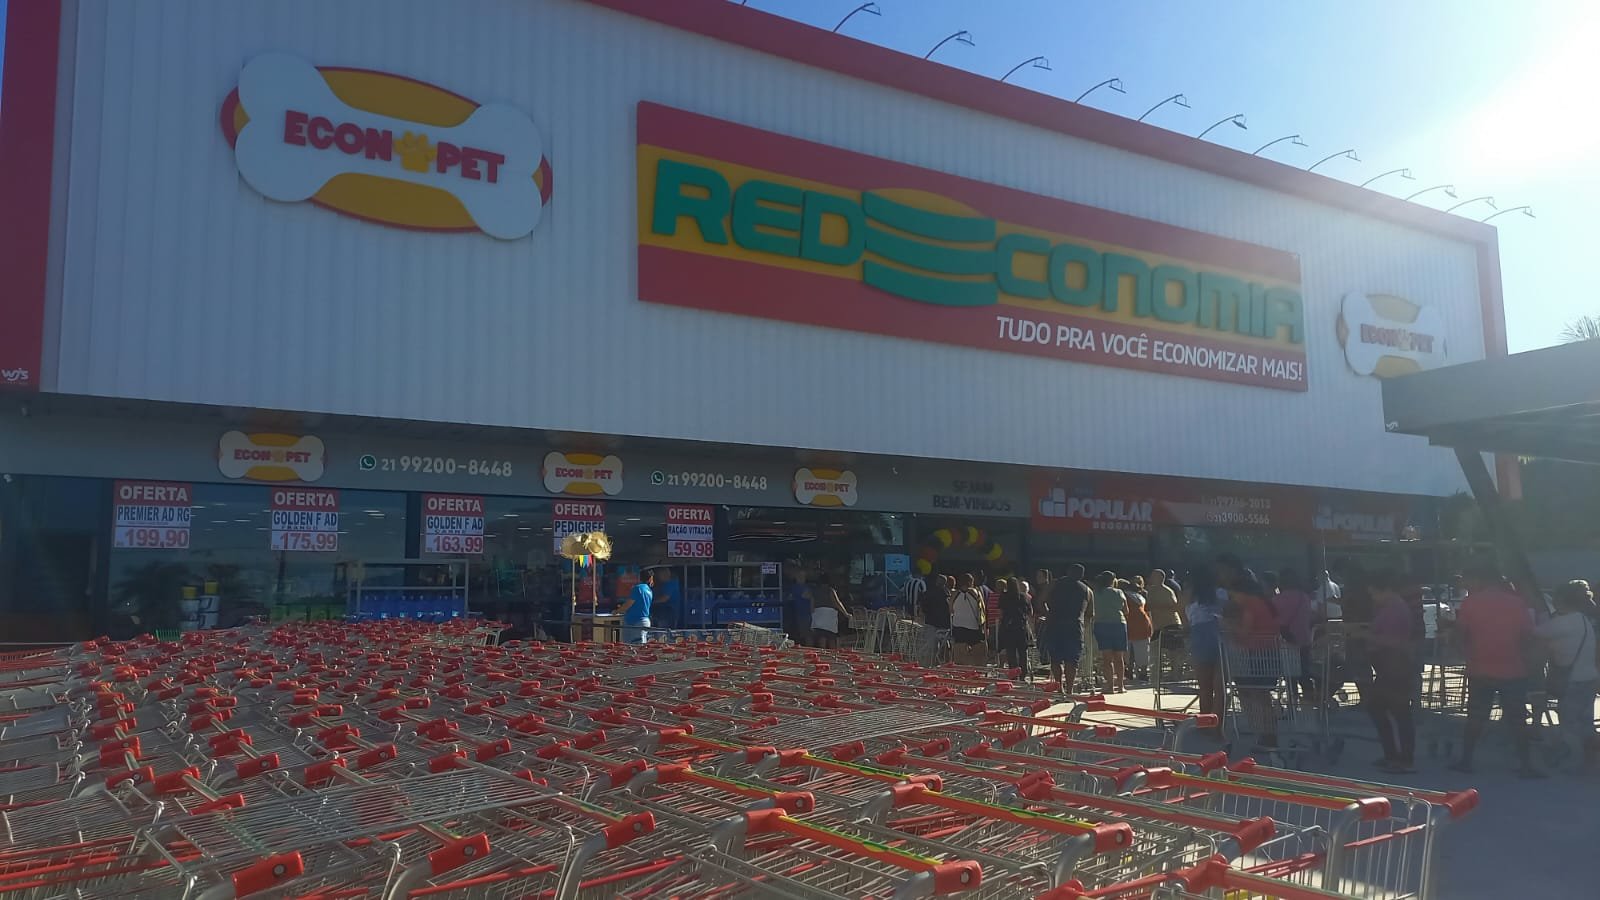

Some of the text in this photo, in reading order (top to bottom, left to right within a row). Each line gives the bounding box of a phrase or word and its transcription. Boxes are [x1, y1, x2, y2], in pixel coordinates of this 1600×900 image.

[996, 316, 1303, 382] TUDO PRA VOCÊ ECONOMIZAR MAIS!
[381, 455, 513, 477] 21 99200-8448
[667, 472, 768, 490] 21 99200-8448
[119, 485, 188, 502] OFERTA
[274, 491, 336, 507] OFERTA
[427, 497, 482, 512] OFERTA
[554, 503, 603, 517] OFERTA
[1067, 496, 1153, 521] POPULAR
[117, 506, 190, 522] PREMIER AD RG
[273, 511, 337, 527] GOLDEN F AD
[668, 508, 711, 521] OFERTA
[427, 516, 483, 530] GOLDEN F AD
